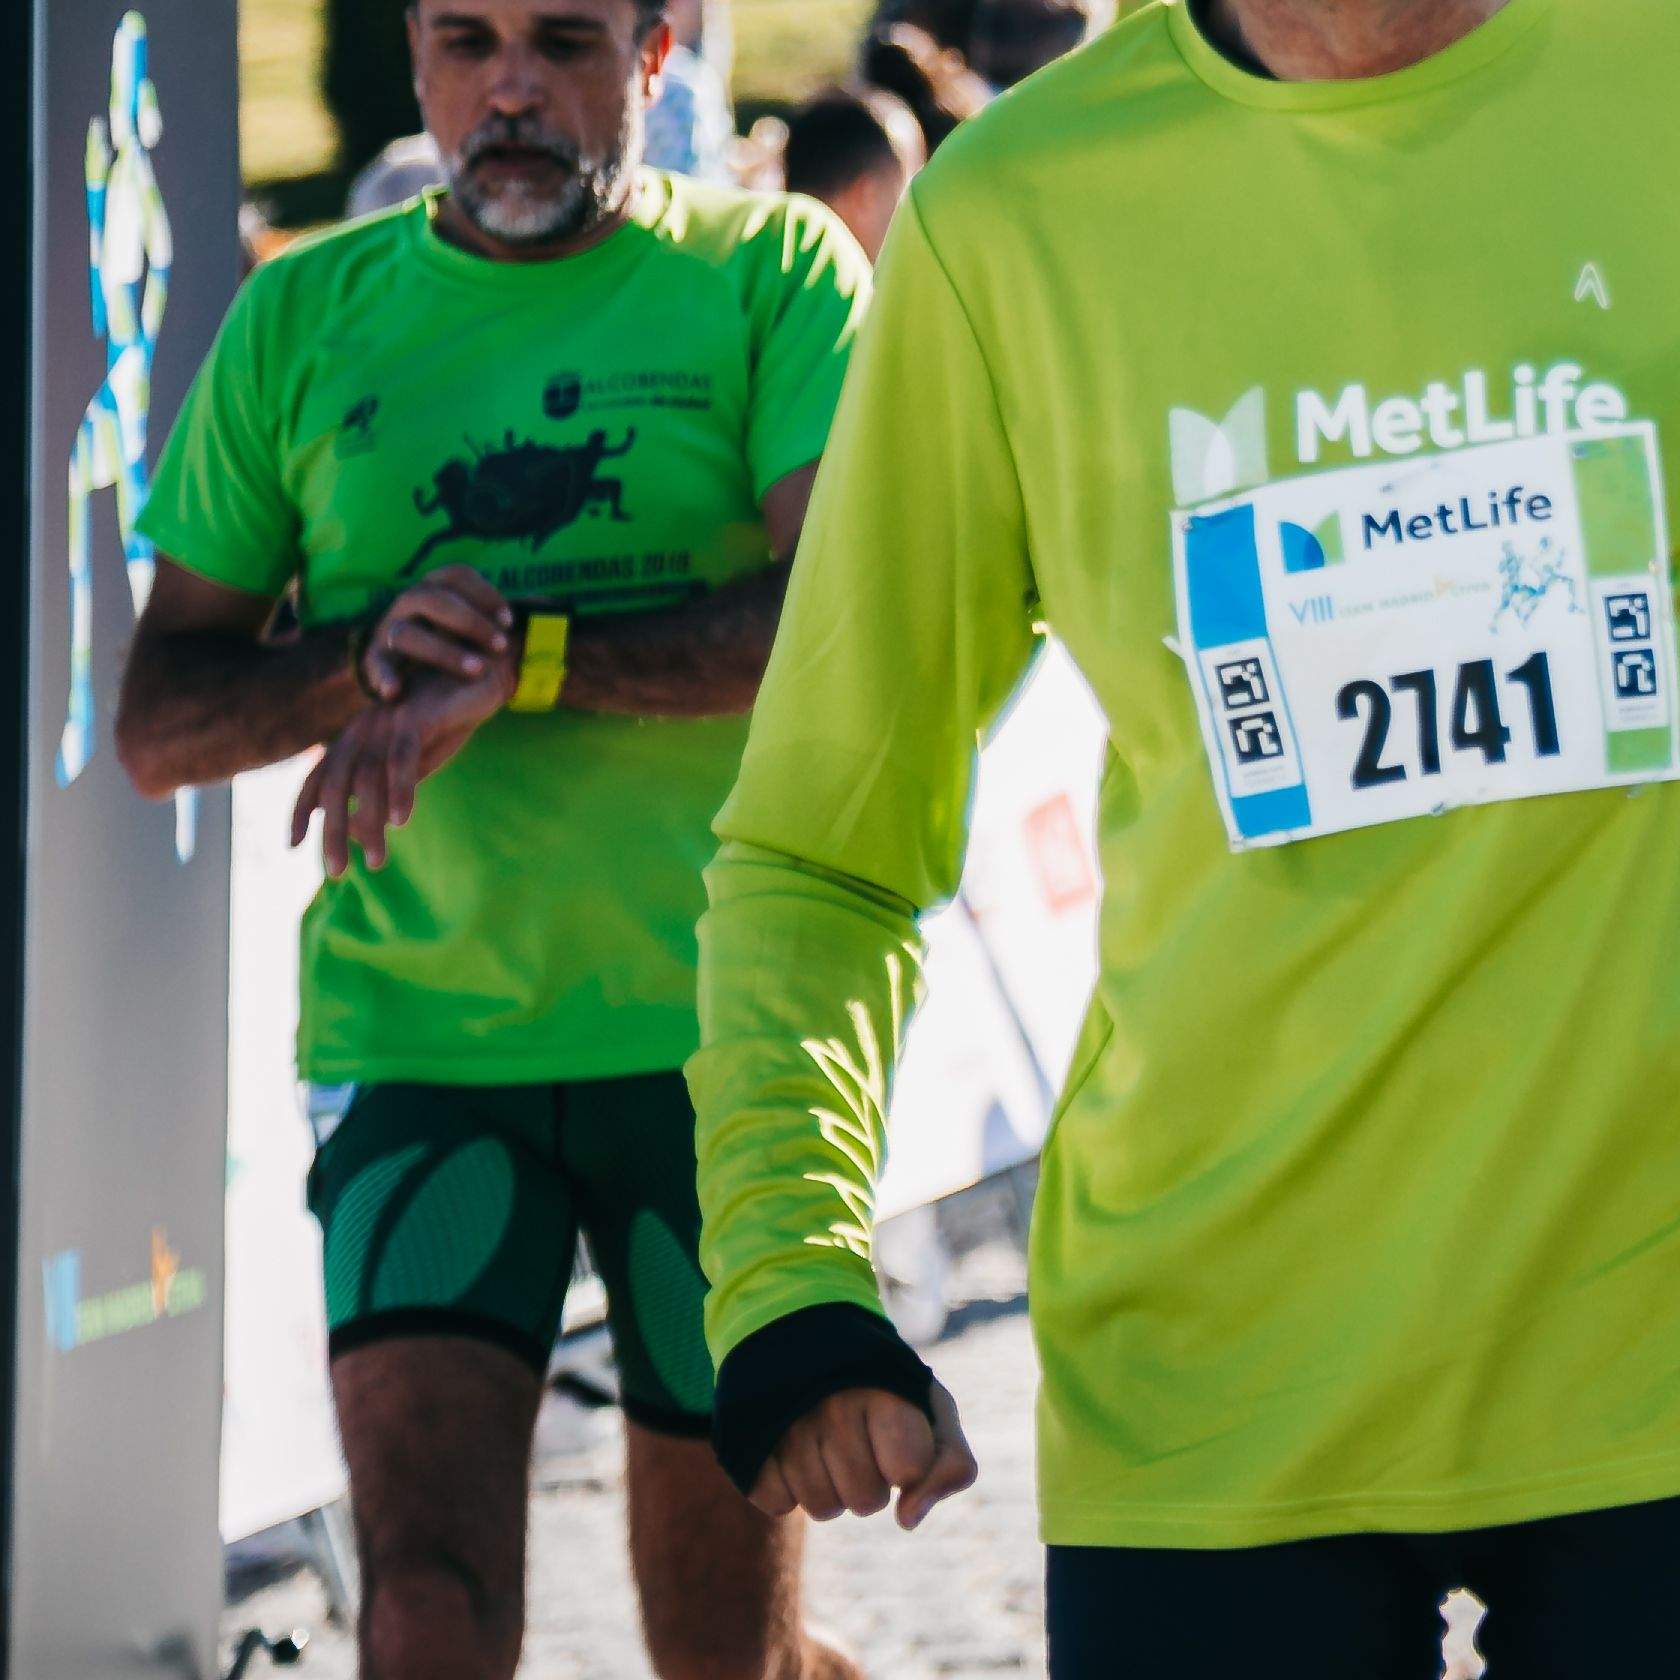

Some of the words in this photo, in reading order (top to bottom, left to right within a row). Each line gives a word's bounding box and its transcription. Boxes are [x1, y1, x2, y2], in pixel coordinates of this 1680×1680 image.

[1298, 362, 1628, 463] MetLife
[1360, 485, 1554, 550] MetLife
[1333, 649, 1562, 791] 2741
